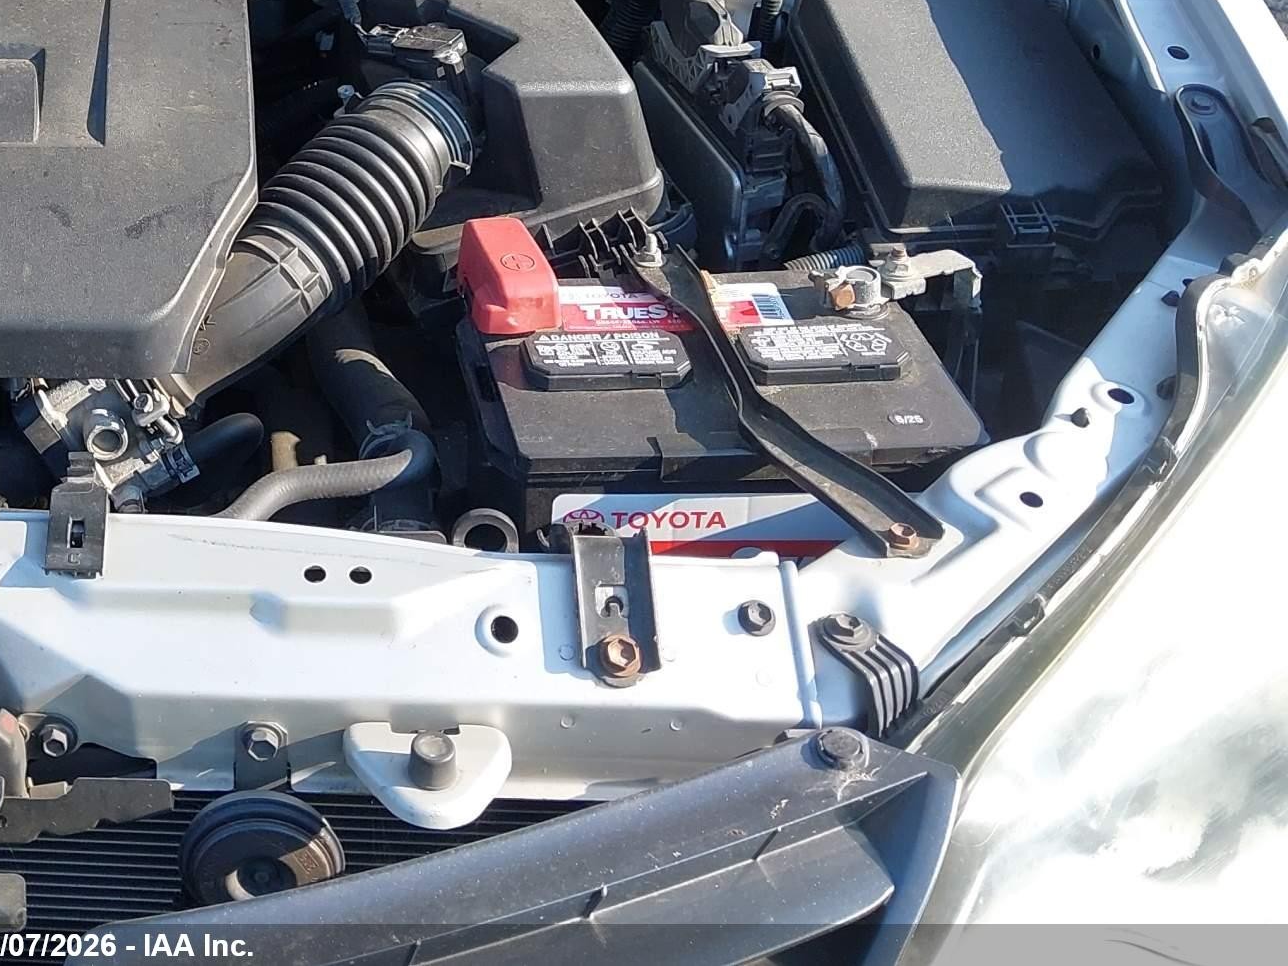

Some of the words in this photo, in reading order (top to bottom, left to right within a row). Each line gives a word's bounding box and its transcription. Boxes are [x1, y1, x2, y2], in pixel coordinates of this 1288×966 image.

[550, 333, 600, 342] DANGER
[613, 331, 660, 340] POISON
[611, 511, 727, 530] TOYOTA
